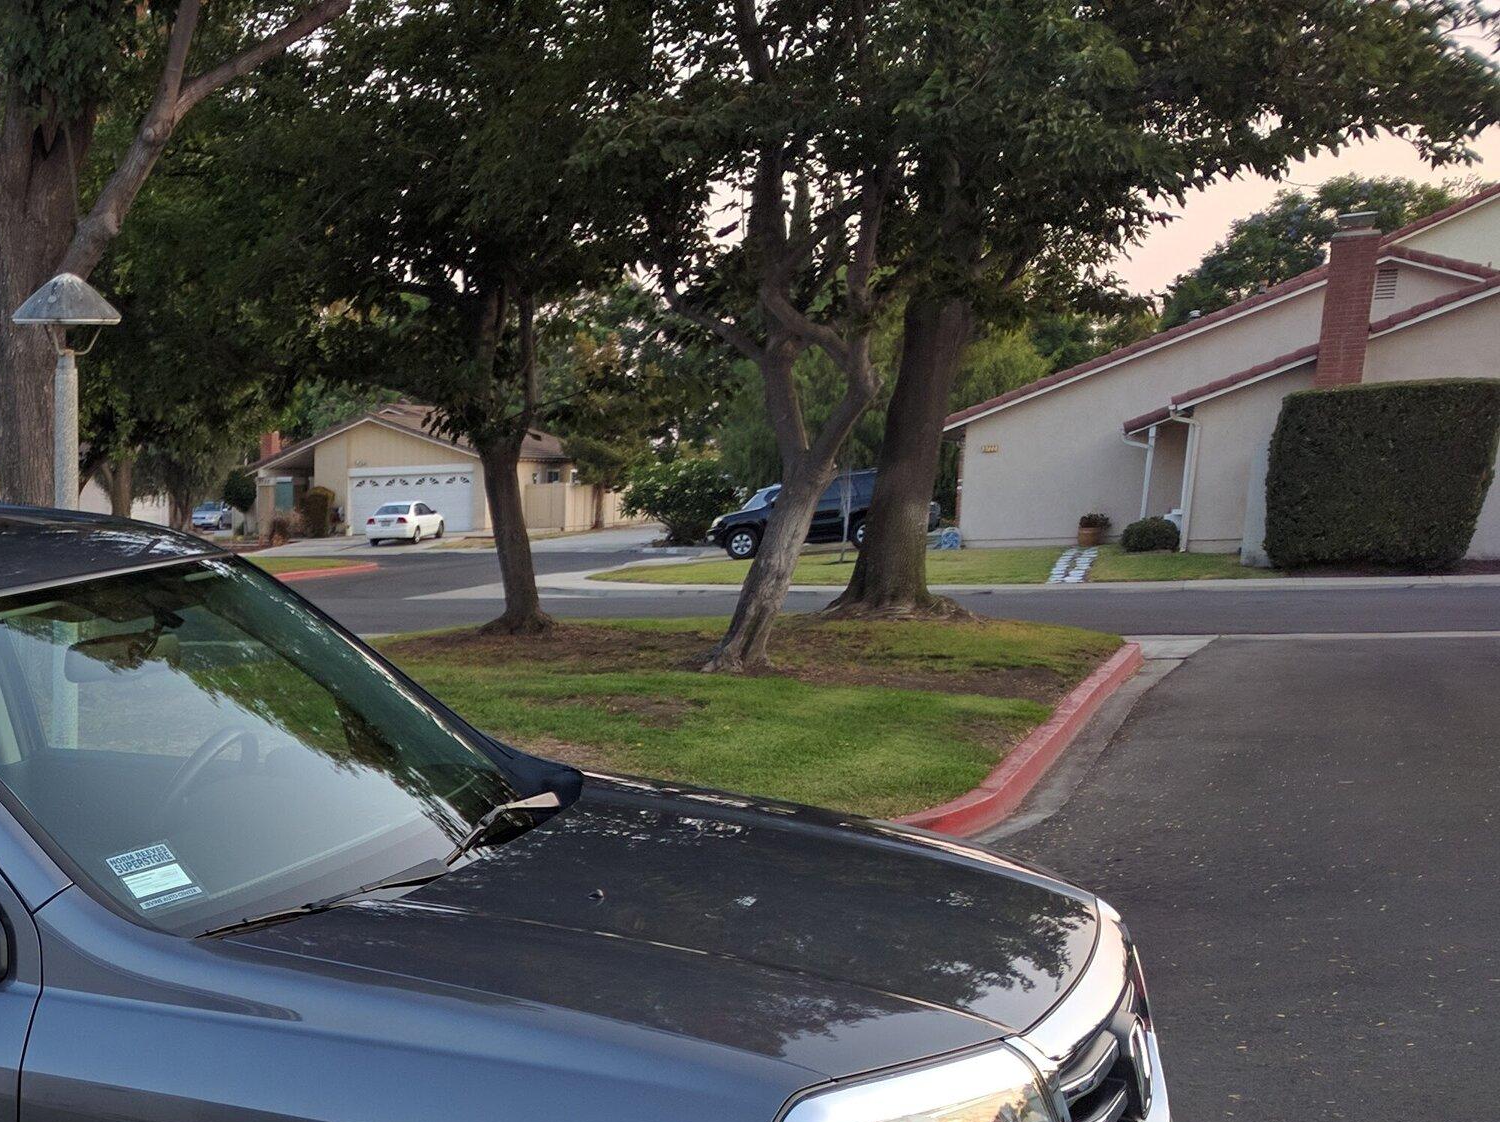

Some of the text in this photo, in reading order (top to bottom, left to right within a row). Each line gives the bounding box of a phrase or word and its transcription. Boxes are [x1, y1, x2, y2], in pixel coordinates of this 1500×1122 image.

[109, 845, 167, 865] NORM REEVES
[114, 850, 173, 873] SUPERSTORE
[163, 893, 179, 902] AUTO
